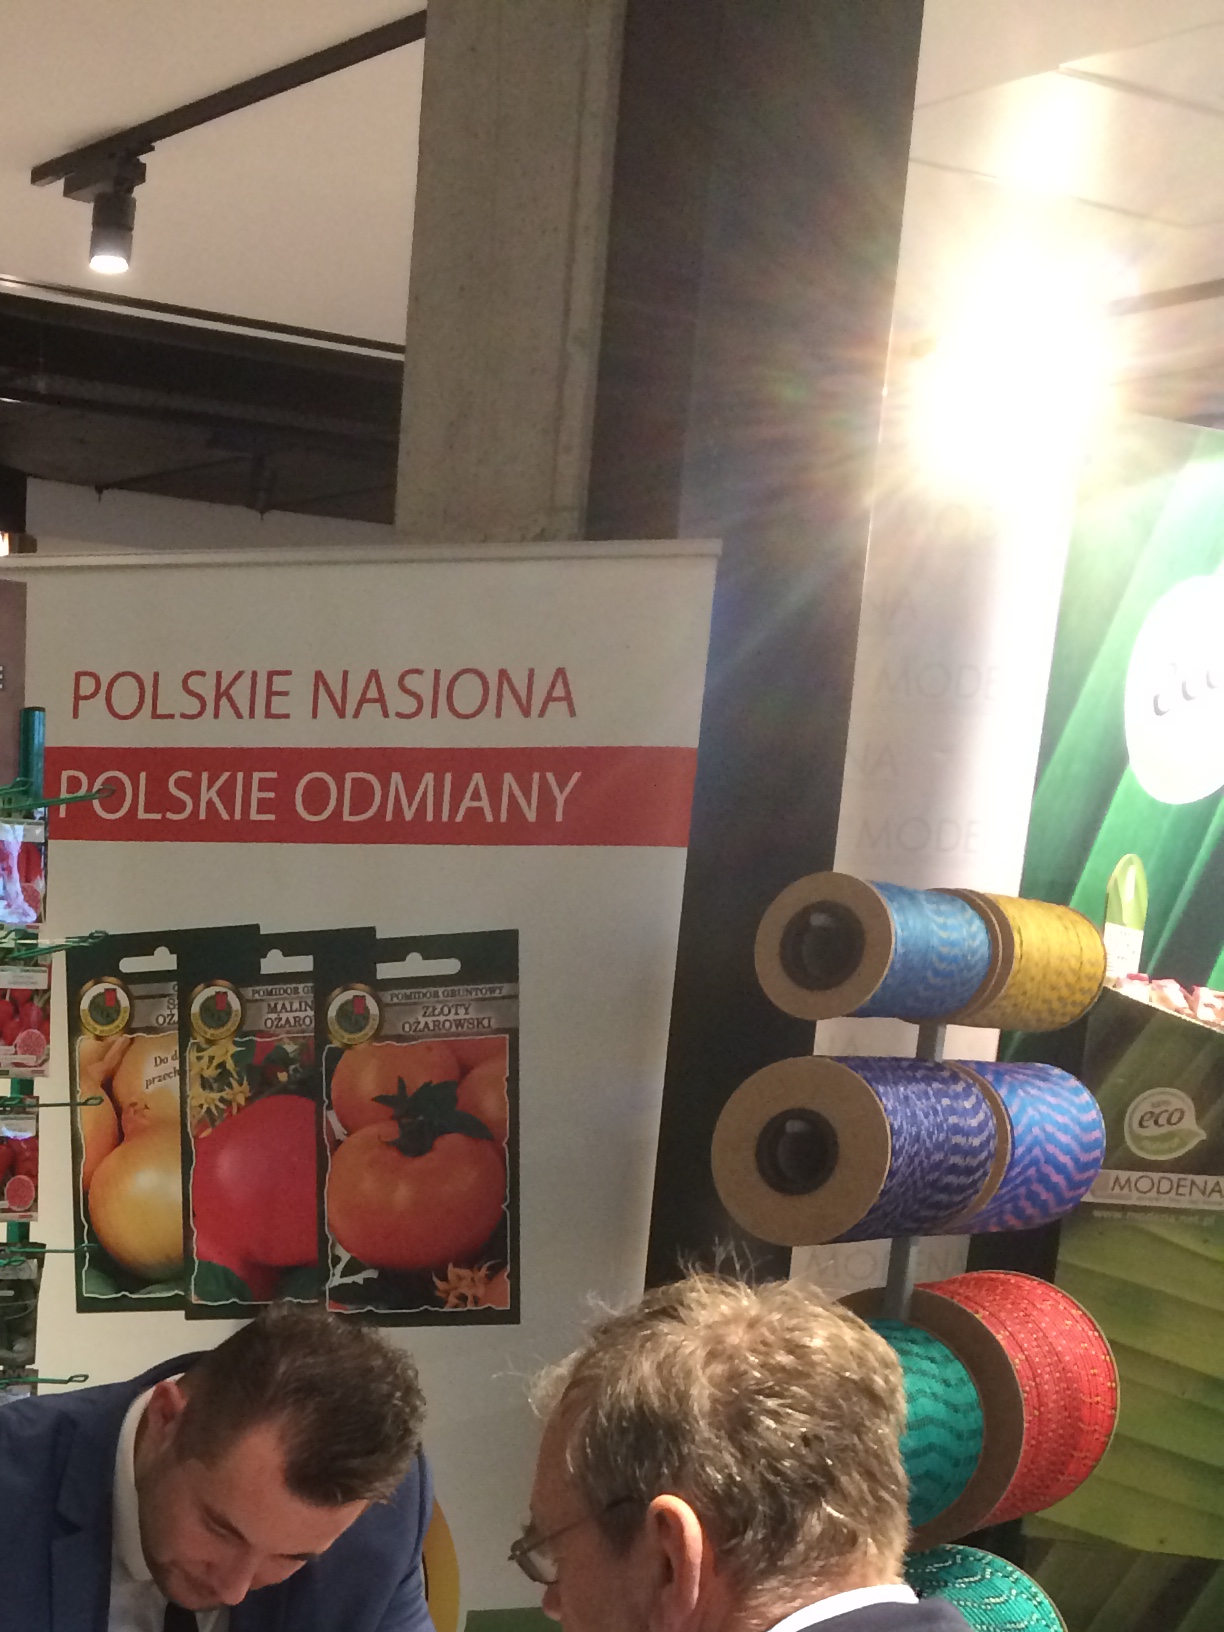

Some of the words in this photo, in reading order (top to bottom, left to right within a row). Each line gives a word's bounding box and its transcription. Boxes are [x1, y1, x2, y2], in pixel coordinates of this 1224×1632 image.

[71, 669, 293, 721] POLSKIE
[311, 666, 578, 720] NASIONA
[59, 769, 278, 821] POLSKIE
[295, 769, 583, 823] ODMIANY
[251, 987, 300, 999] POMIDOR
[390, 989, 441, 1002] POMIDOR
[442, 986, 504, 999] GRUNTOWY
[422, 1003, 472, 1018] ZŁOTY
[264, 1013, 315, 1030] OŻARO
[402, 1016, 493, 1033] OŻAROWSKI
[1138, 1107, 1186, 1129] eco
[1111, 1174, 1224, 1199] MODENA
